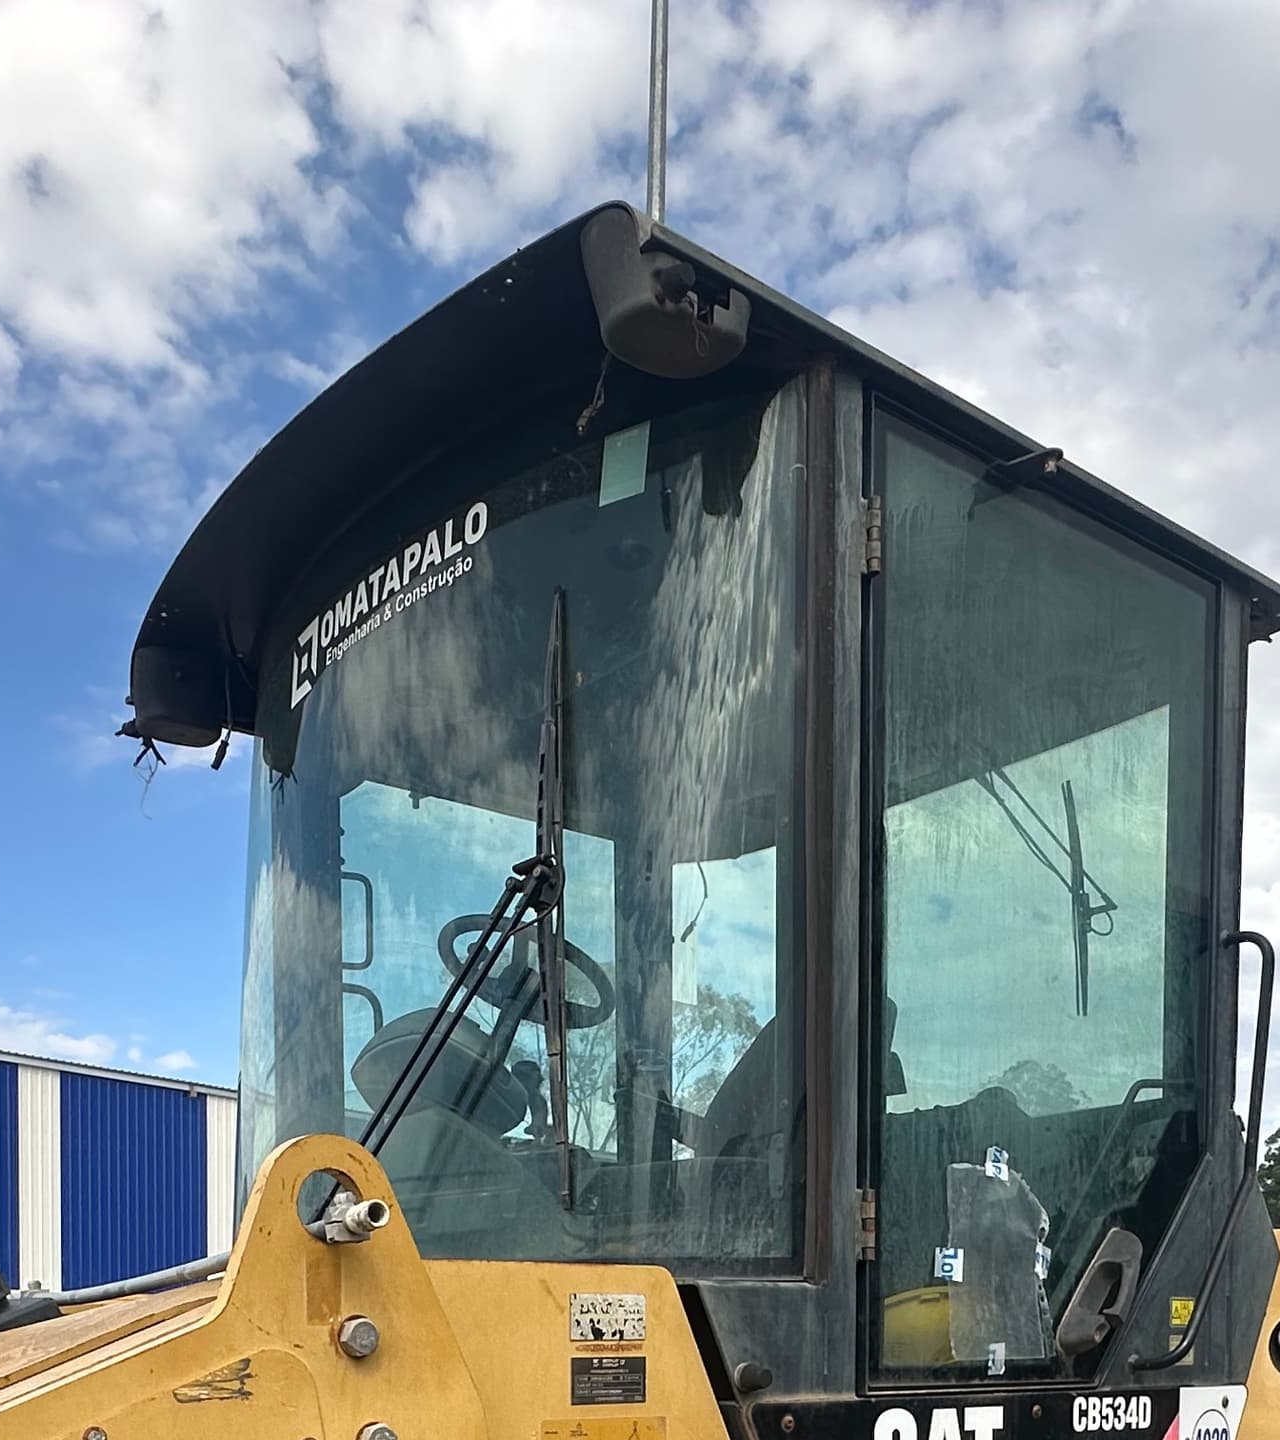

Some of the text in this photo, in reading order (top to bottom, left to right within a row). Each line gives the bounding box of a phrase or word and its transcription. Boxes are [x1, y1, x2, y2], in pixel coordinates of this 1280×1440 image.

[320, 501, 489, 648] OMATAPALO
[325, 556, 473, 667] Engenharia & Construção
[1072, 1396, 1152, 1432] CB534D
